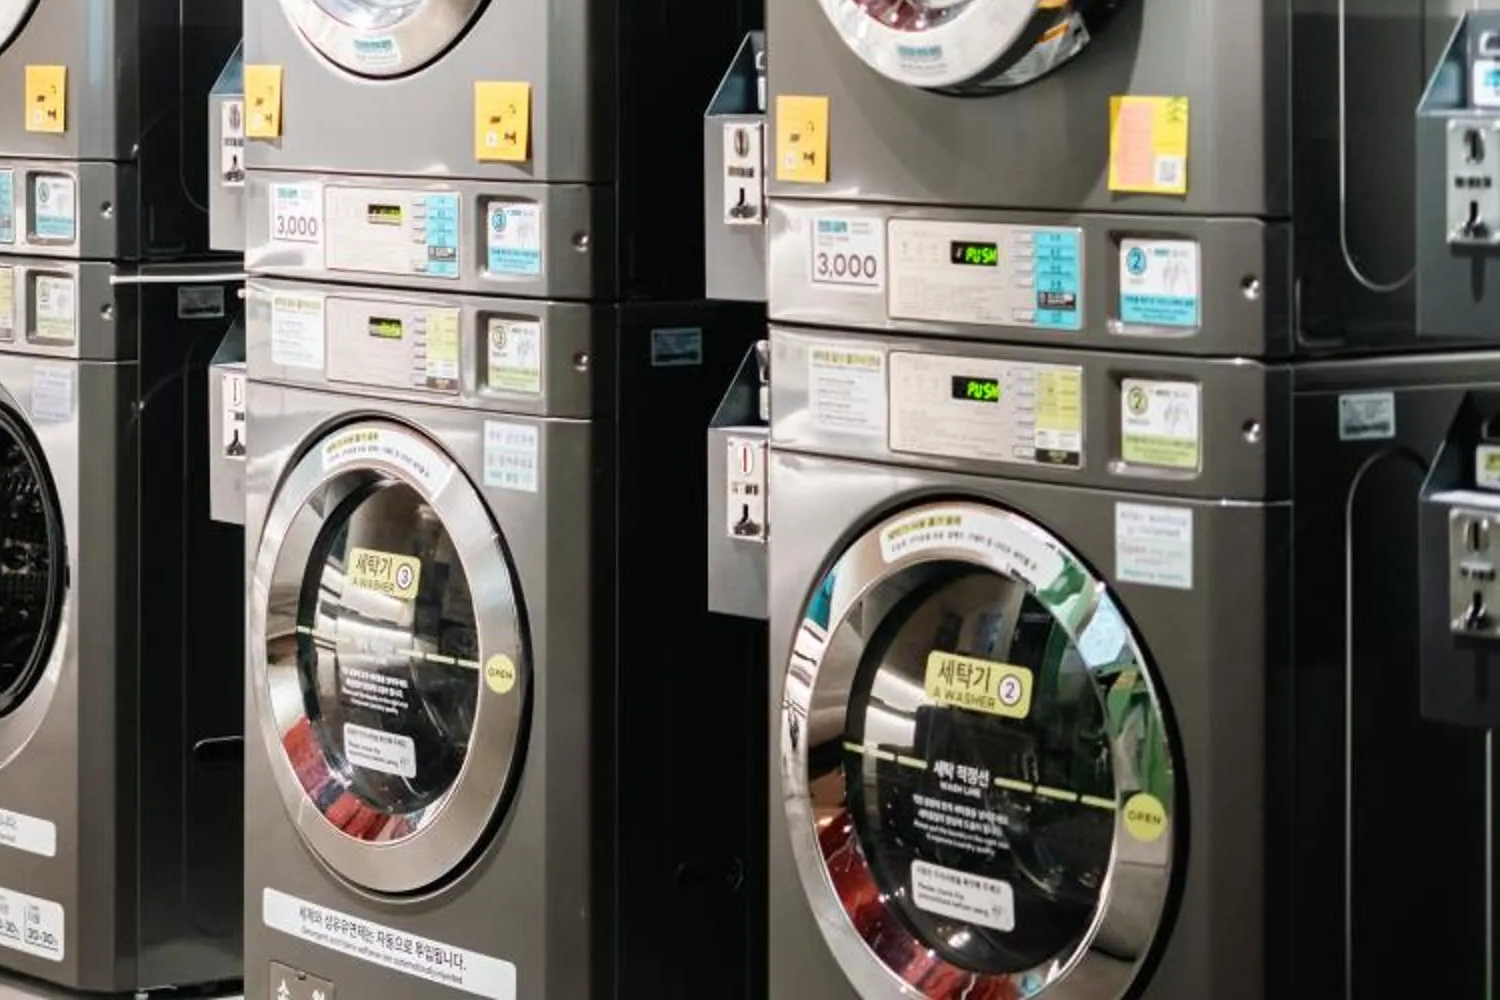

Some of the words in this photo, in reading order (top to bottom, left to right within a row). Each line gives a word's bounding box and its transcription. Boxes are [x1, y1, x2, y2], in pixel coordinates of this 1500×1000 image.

[277, 215, 318, 236] 3,000
[817, 252, 877, 279] 3,000
[355, 552, 392, 580] 세탁기
[938, 660, 991, 693] 세탁기
[945, 688, 996, 710] WASHER
[1127, 810, 1161, 825] OPEN
